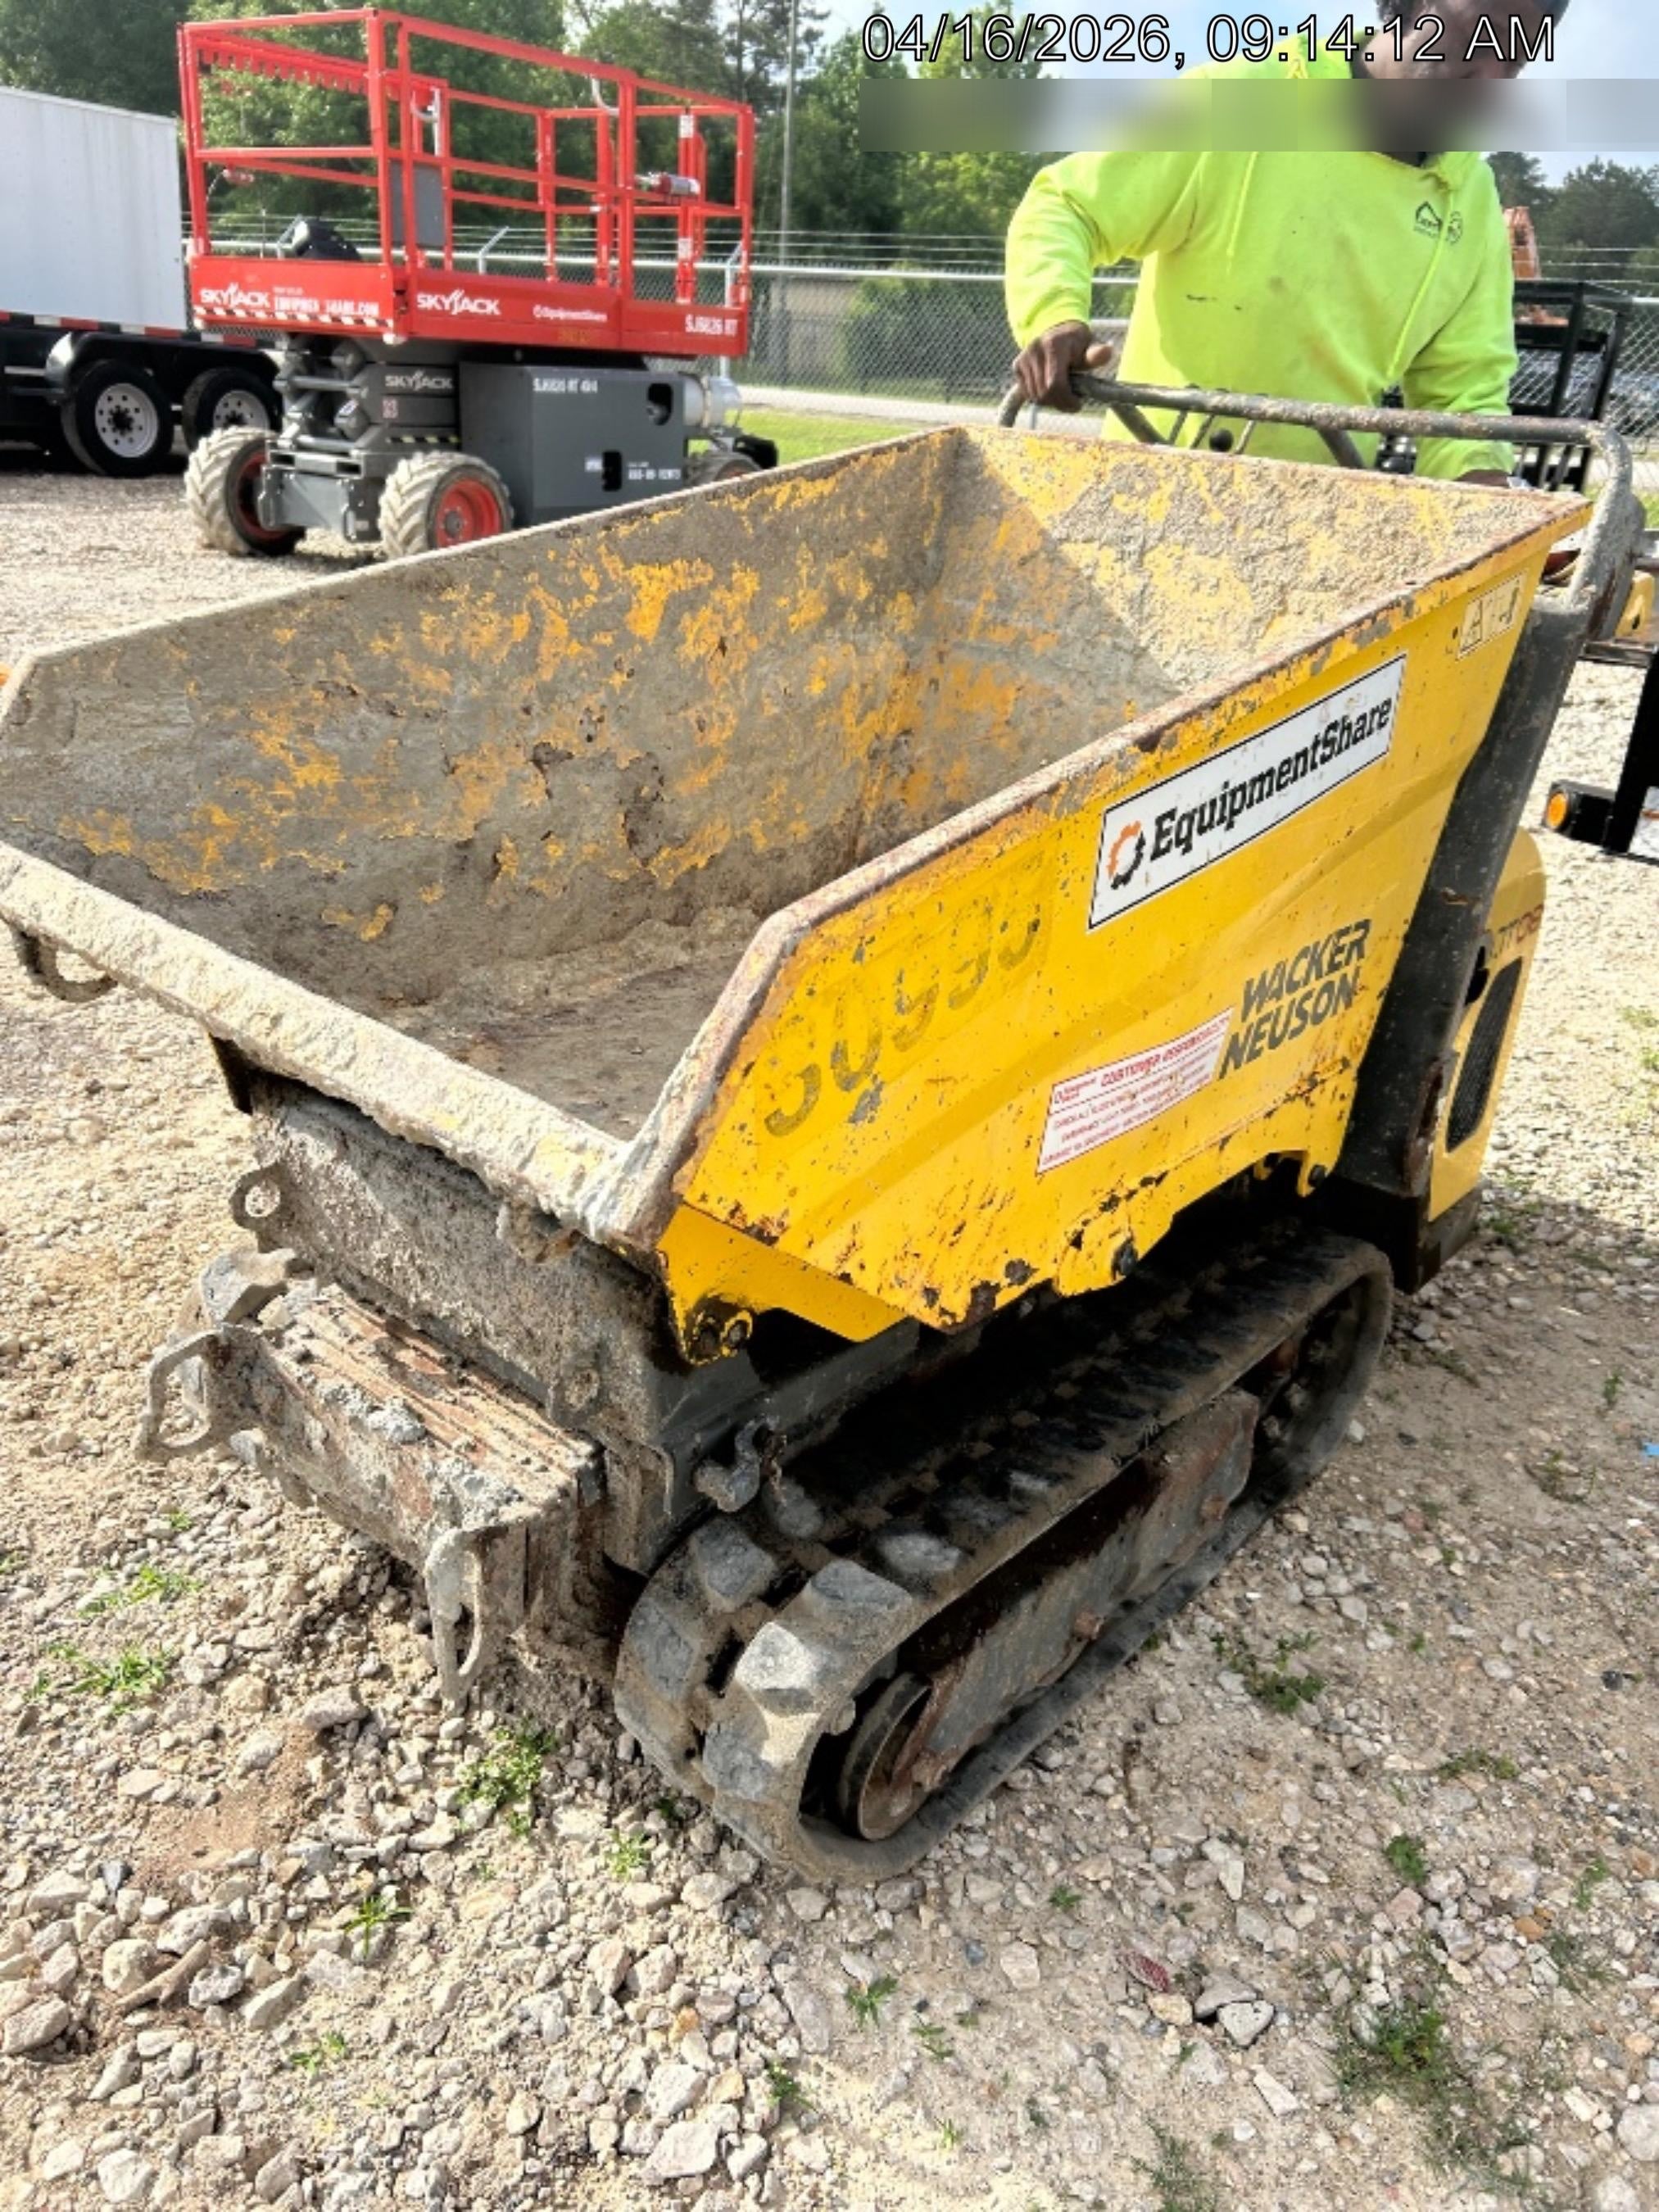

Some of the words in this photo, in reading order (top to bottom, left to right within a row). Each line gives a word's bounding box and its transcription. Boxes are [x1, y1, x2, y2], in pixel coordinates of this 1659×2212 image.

[200, 283, 270, 307] SKYJACK
[416, 289, 501, 315] SKYJACK
[385, 369, 454, 392] SKYJACK
[1149, 697, 1393, 861] EquipmentShare
[1241, 919, 1372, 1022] WACKER
[1219, 965, 1361, 1080] NEUSON
